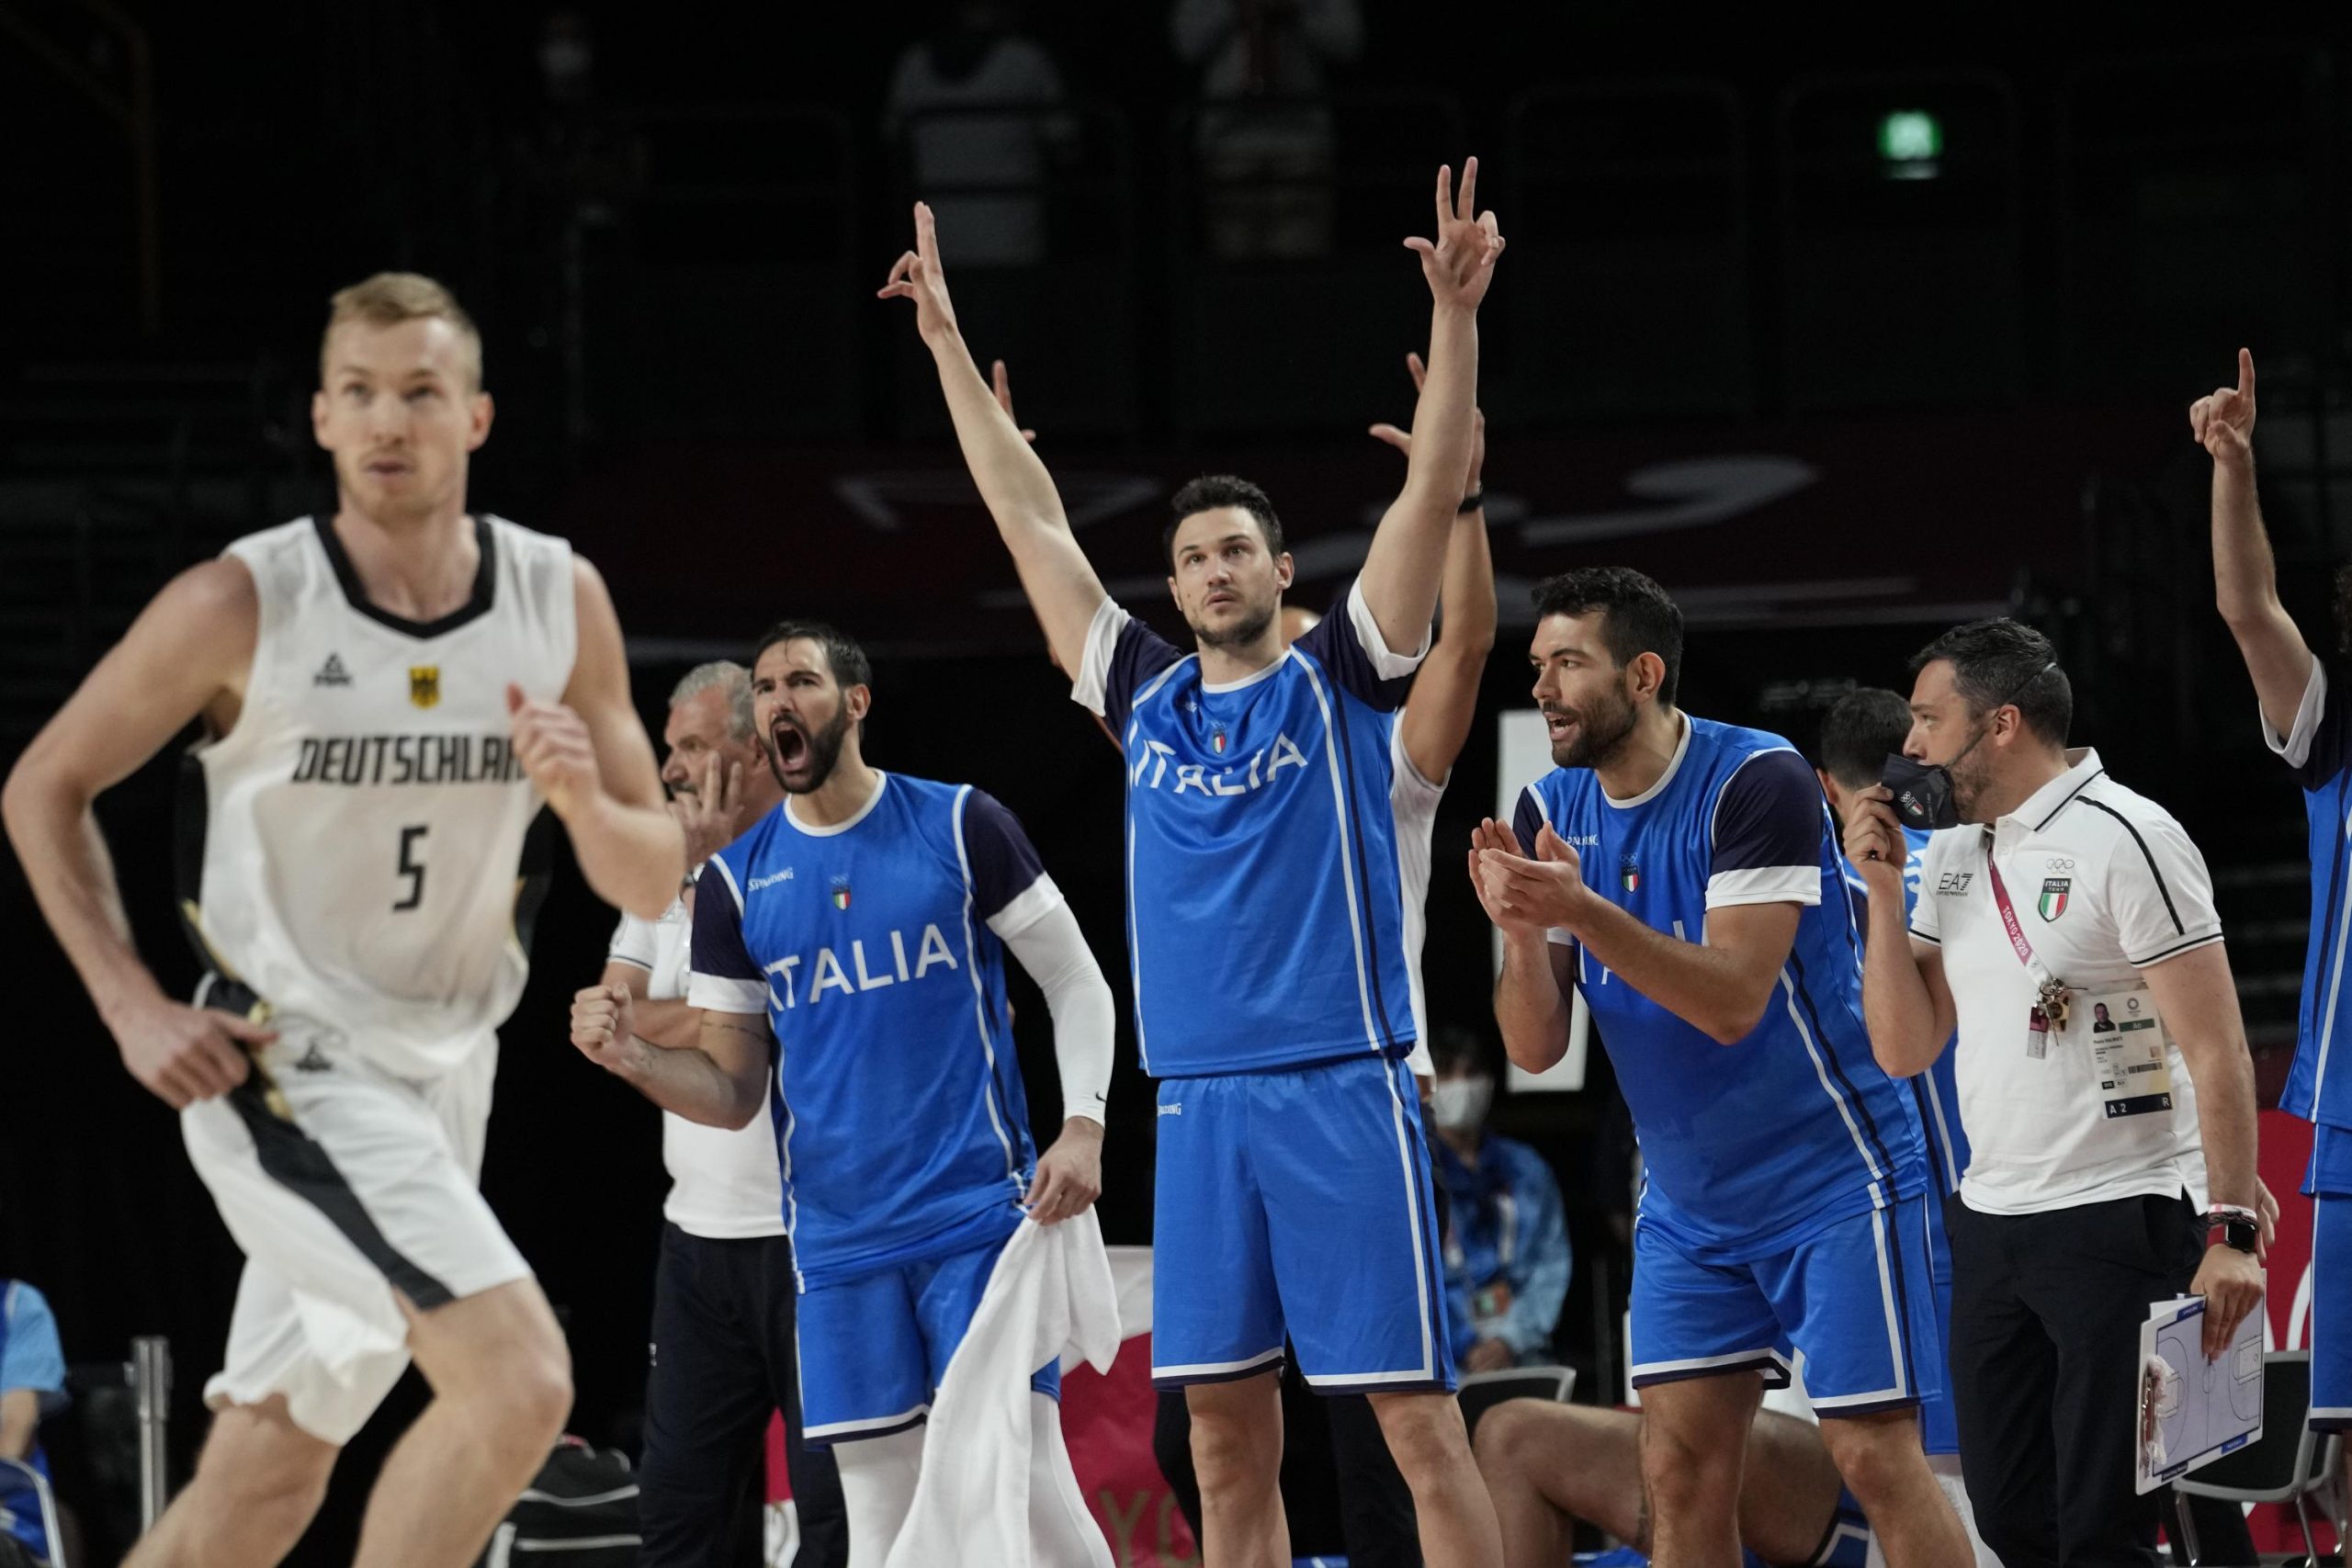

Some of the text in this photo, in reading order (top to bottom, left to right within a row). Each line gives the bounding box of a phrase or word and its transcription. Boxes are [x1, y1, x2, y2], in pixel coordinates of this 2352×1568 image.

[292, 735, 526, 785] DEUTSCHLAN
[1134, 731, 1310, 796] ITALIA
[392, 824, 429, 911] 5
[1939, 873, 1973, 891] EA7
[2002, 906, 2029, 956] TOKYO 2020
[2109, 1096, 2170, 1114] A 2 R
